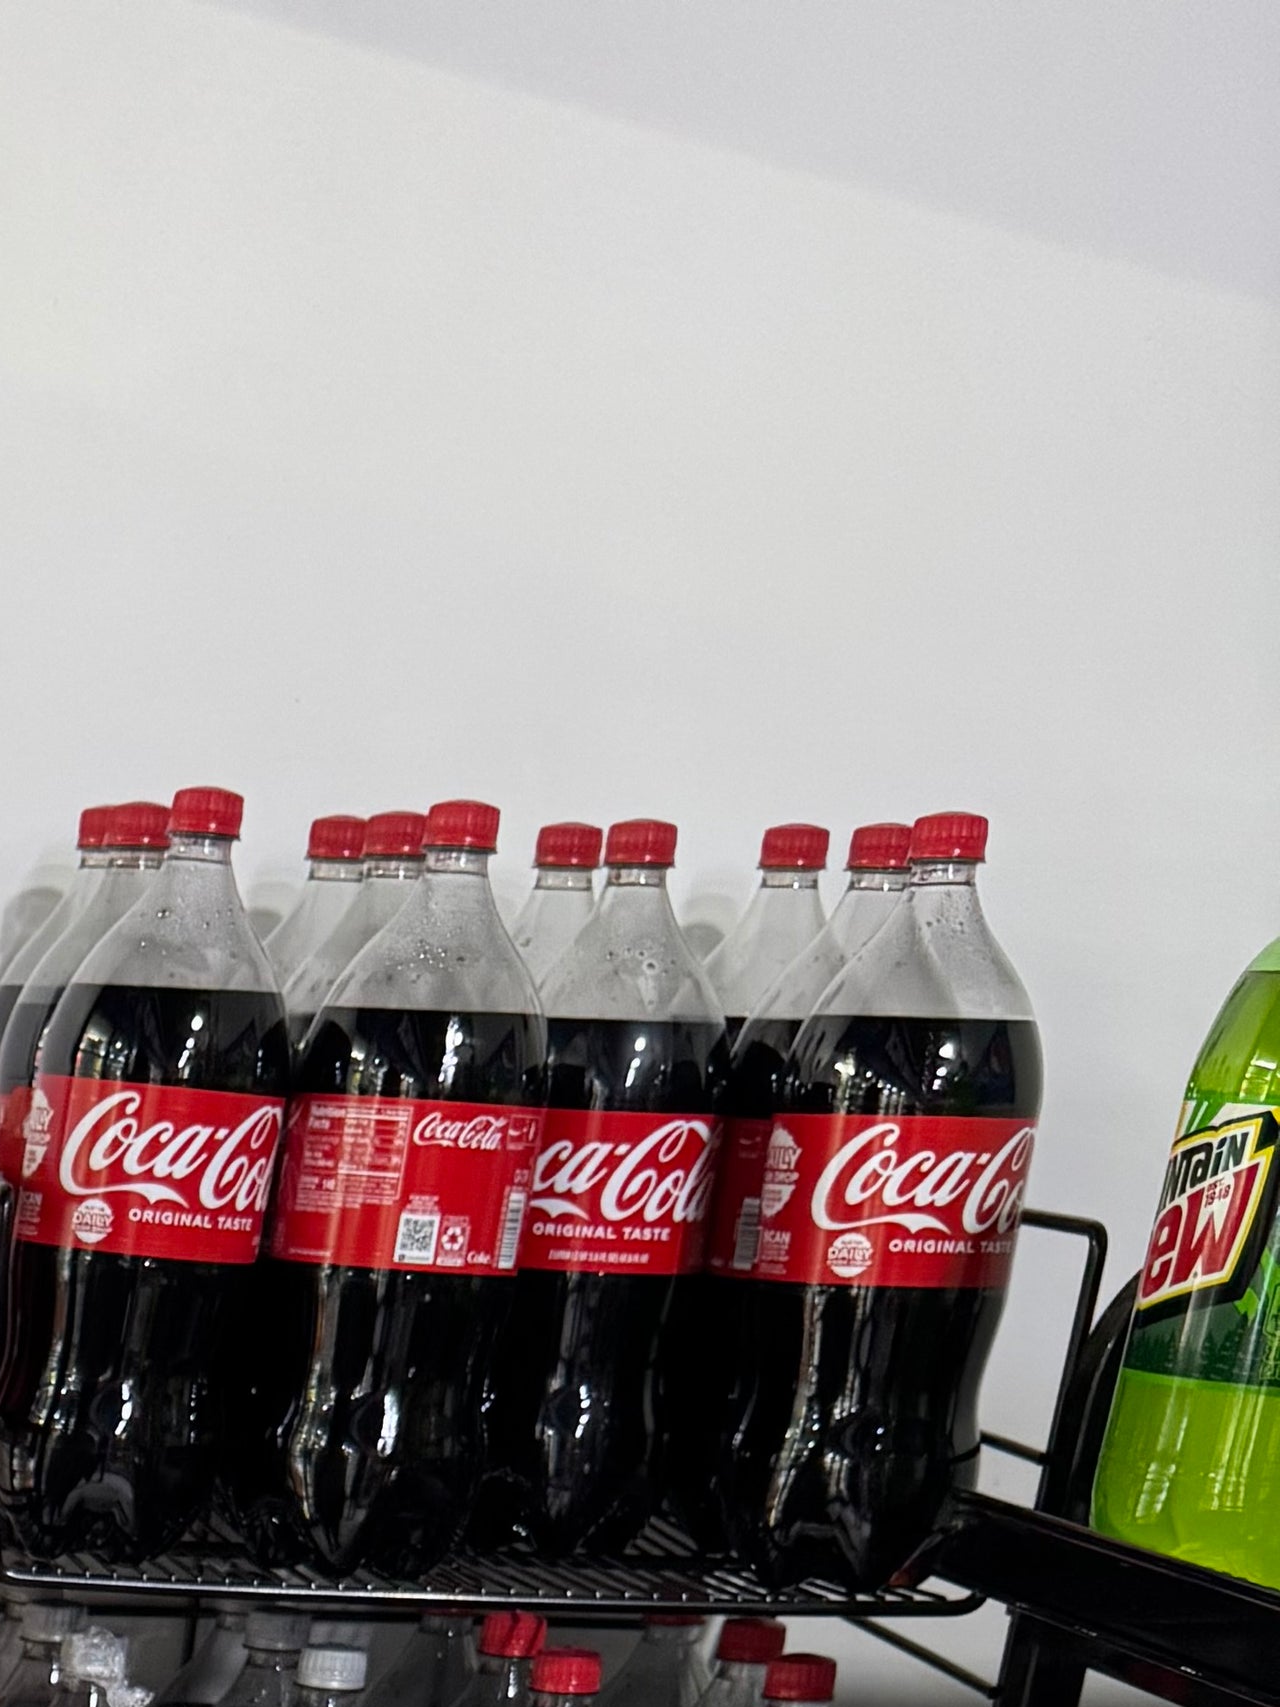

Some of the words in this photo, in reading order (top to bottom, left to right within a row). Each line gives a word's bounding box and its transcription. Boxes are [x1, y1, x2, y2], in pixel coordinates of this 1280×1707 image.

[128, 1206, 212, 1229] ORIGINAL
[217, 1216, 253, 1232] TASTE
[532, 1221, 617, 1240] ORIGINAL
[623, 1226, 671, 1242] TASTE
[888, 1238, 975, 1255] ORIGINAL
